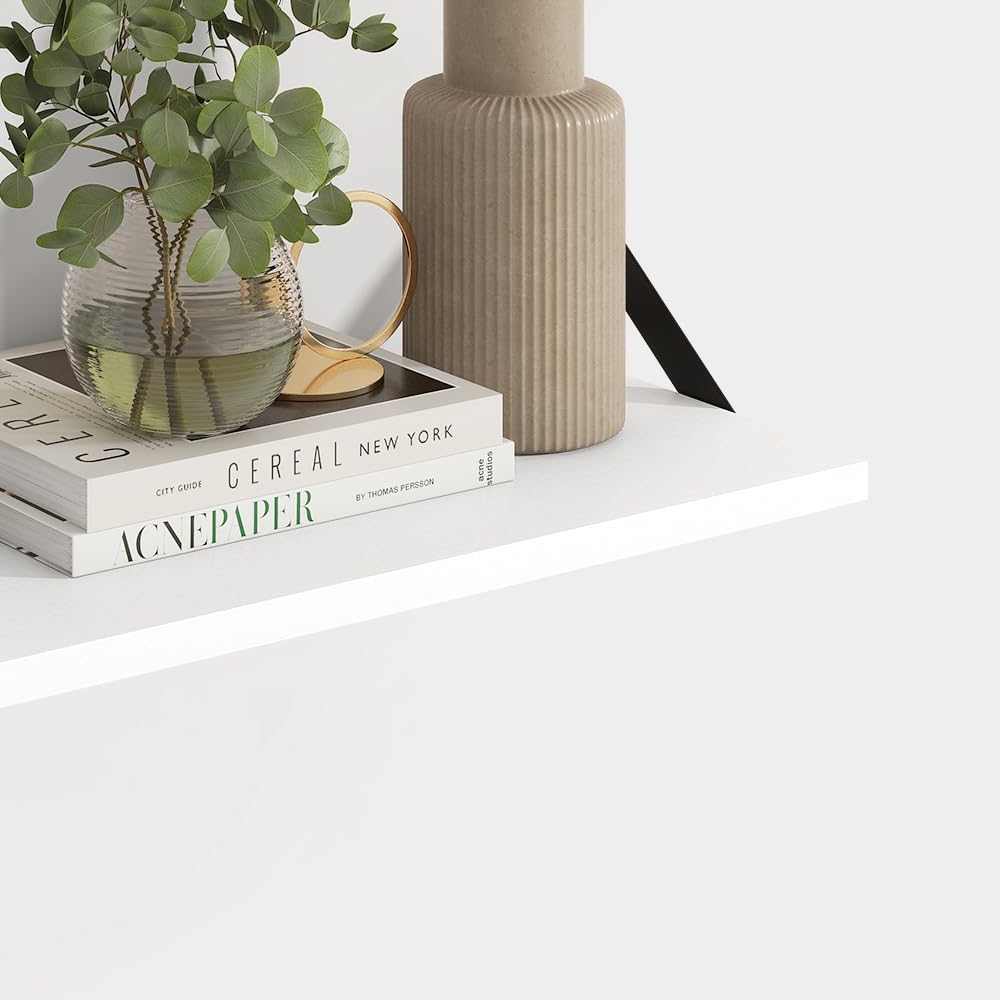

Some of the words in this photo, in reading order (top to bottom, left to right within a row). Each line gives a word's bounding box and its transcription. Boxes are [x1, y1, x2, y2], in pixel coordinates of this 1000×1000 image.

[155, 486, 175, 497] CITY
[178, 480, 203, 492] GUIDE
[227, 441, 342, 489] CEREAL
[358, 435, 399, 456] NEW
[407, 424, 454, 446] YORK
[486, 450, 494, 486] studios
[355, 493, 366, 502] BY
[367, 485, 399, 499] THOMAS
[400, 477, 435, 492] PERSSON
